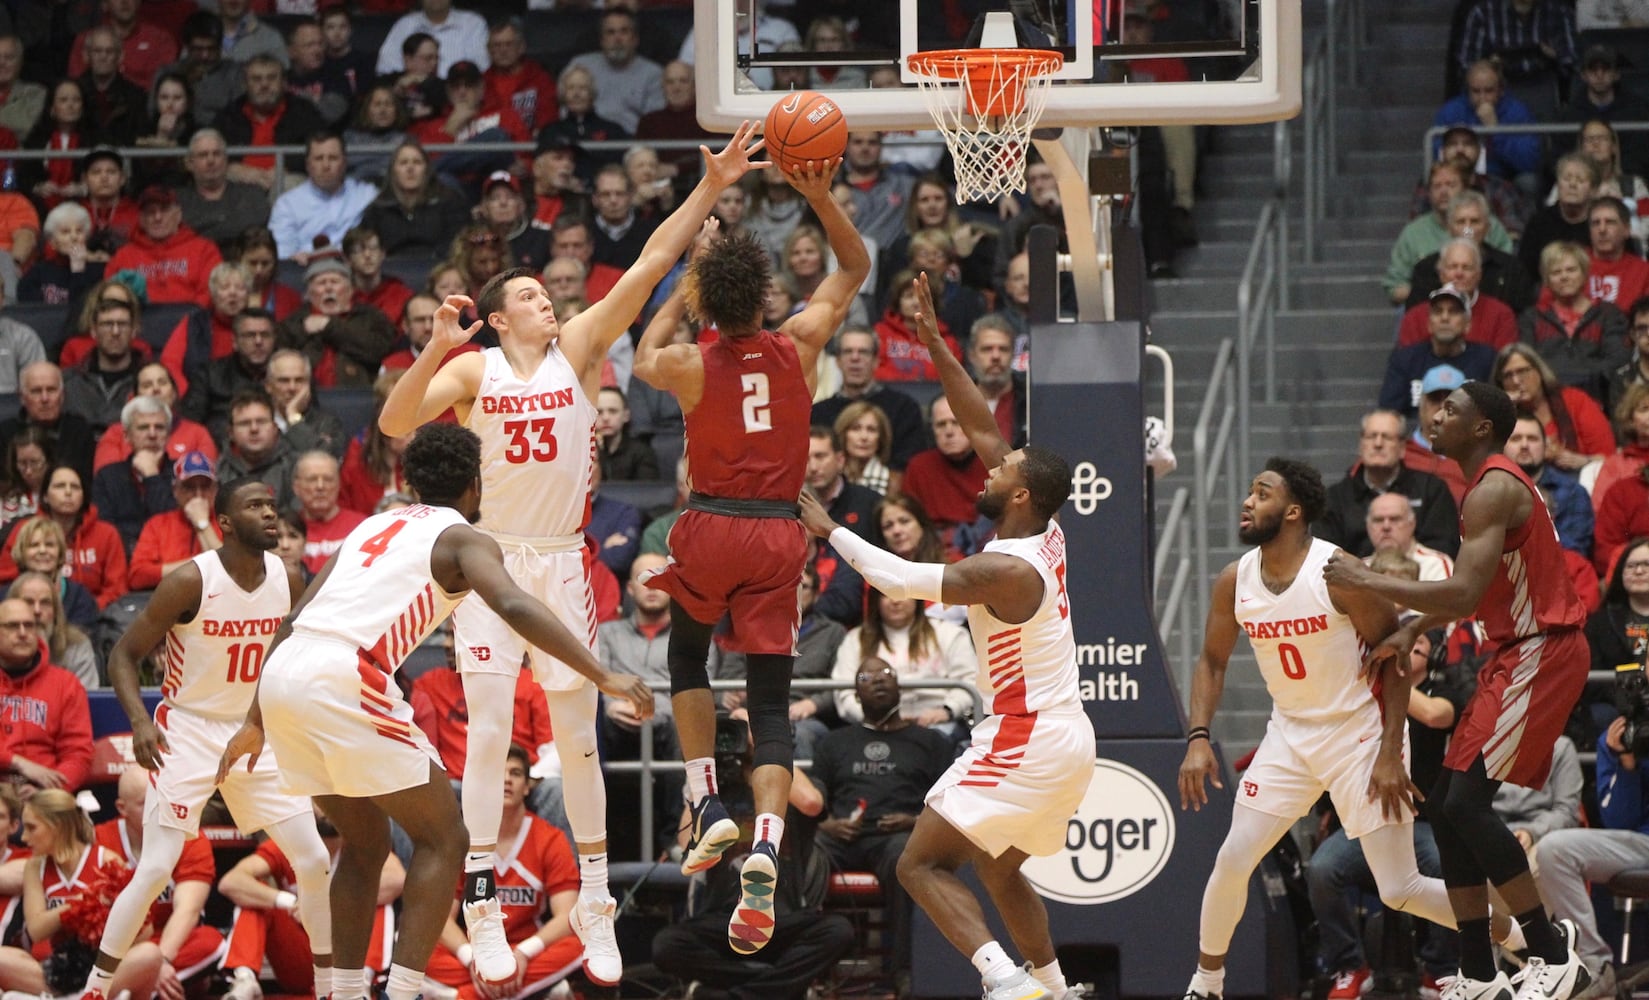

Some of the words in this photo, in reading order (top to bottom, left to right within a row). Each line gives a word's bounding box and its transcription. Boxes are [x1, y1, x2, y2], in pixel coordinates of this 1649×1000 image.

[482, 387, 574, 414] DAYTON
[740, 372, 772, 434] 2
[504, 417, 558, 464] 33
[358, 519, 408, 567] 4
[1244, 615, 1328, 639] DAYTON
[226, 643, 264, 683] 10
[1278, 643, 1306, 680] 0
[853, 763, 895, 775] BUICK
